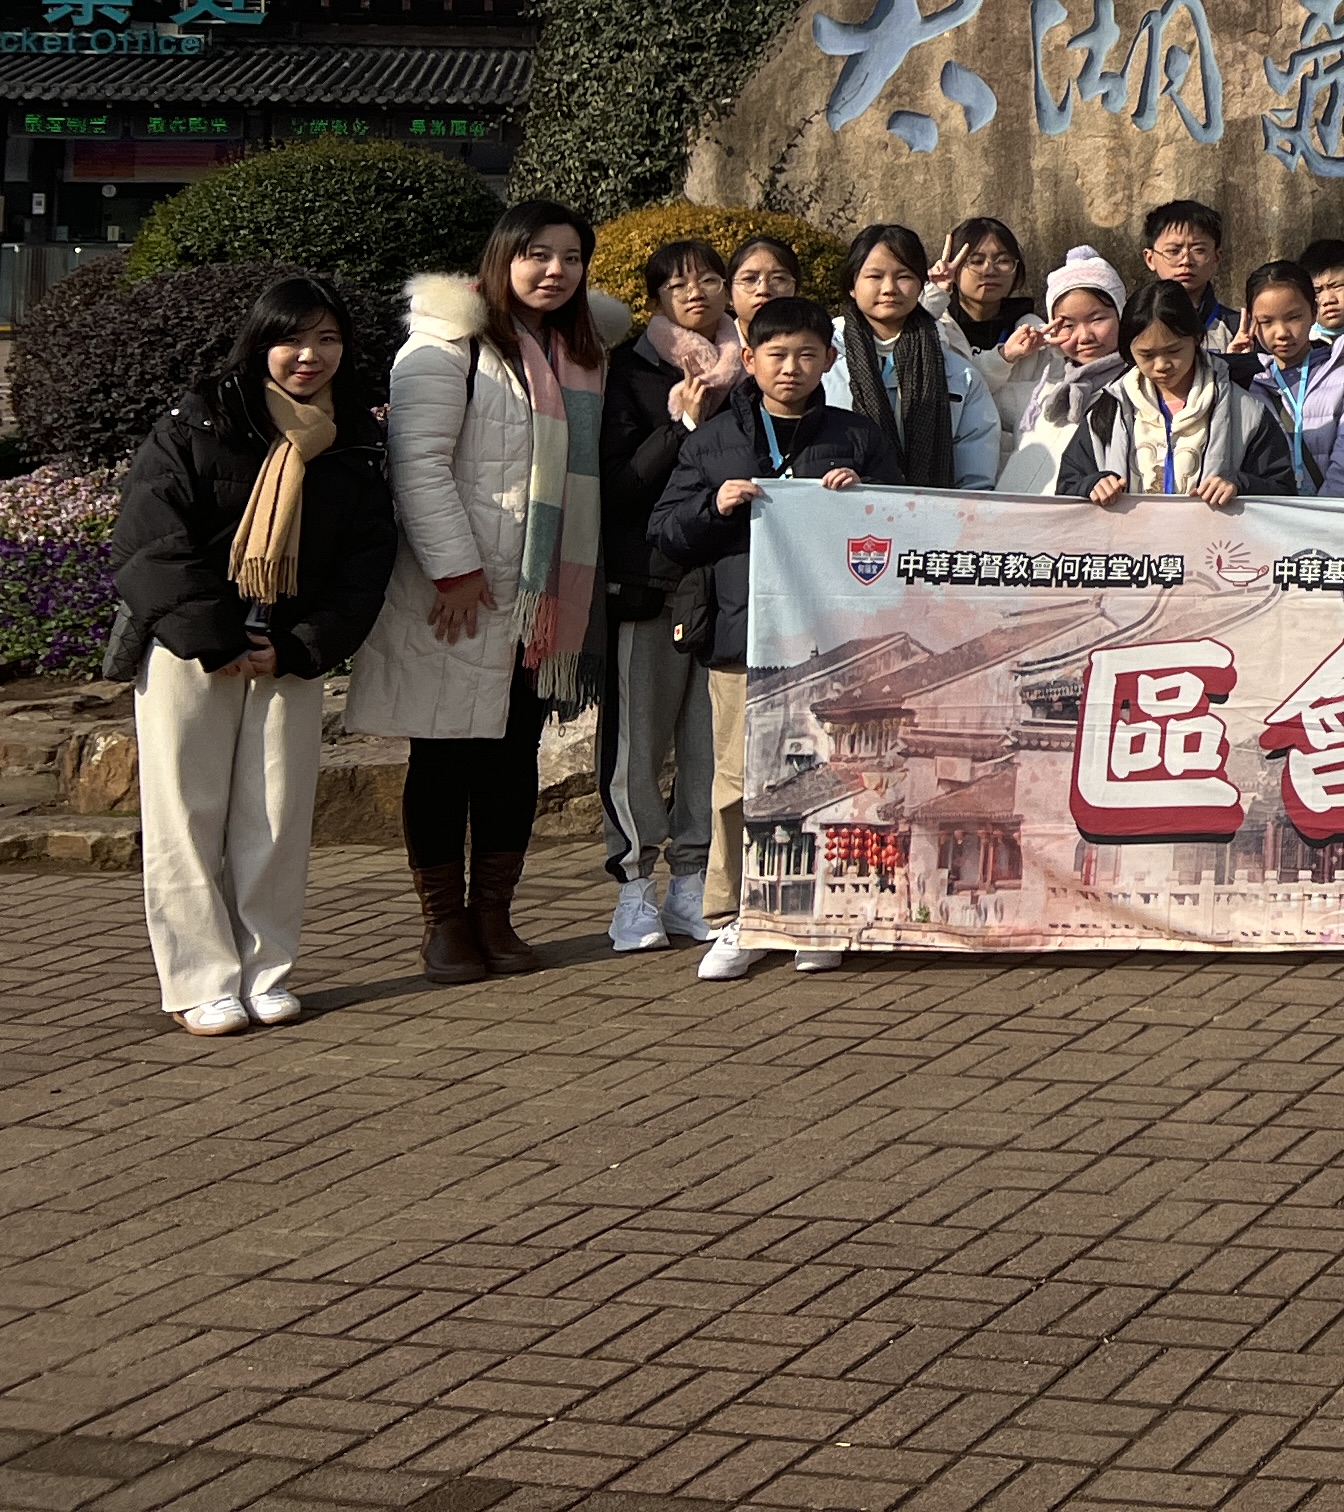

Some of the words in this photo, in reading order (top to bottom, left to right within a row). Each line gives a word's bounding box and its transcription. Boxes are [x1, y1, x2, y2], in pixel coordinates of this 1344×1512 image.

[91, 27, 201, 55] Office
[898, 550, 1184, 587] 中華基督教會何福堂小學
